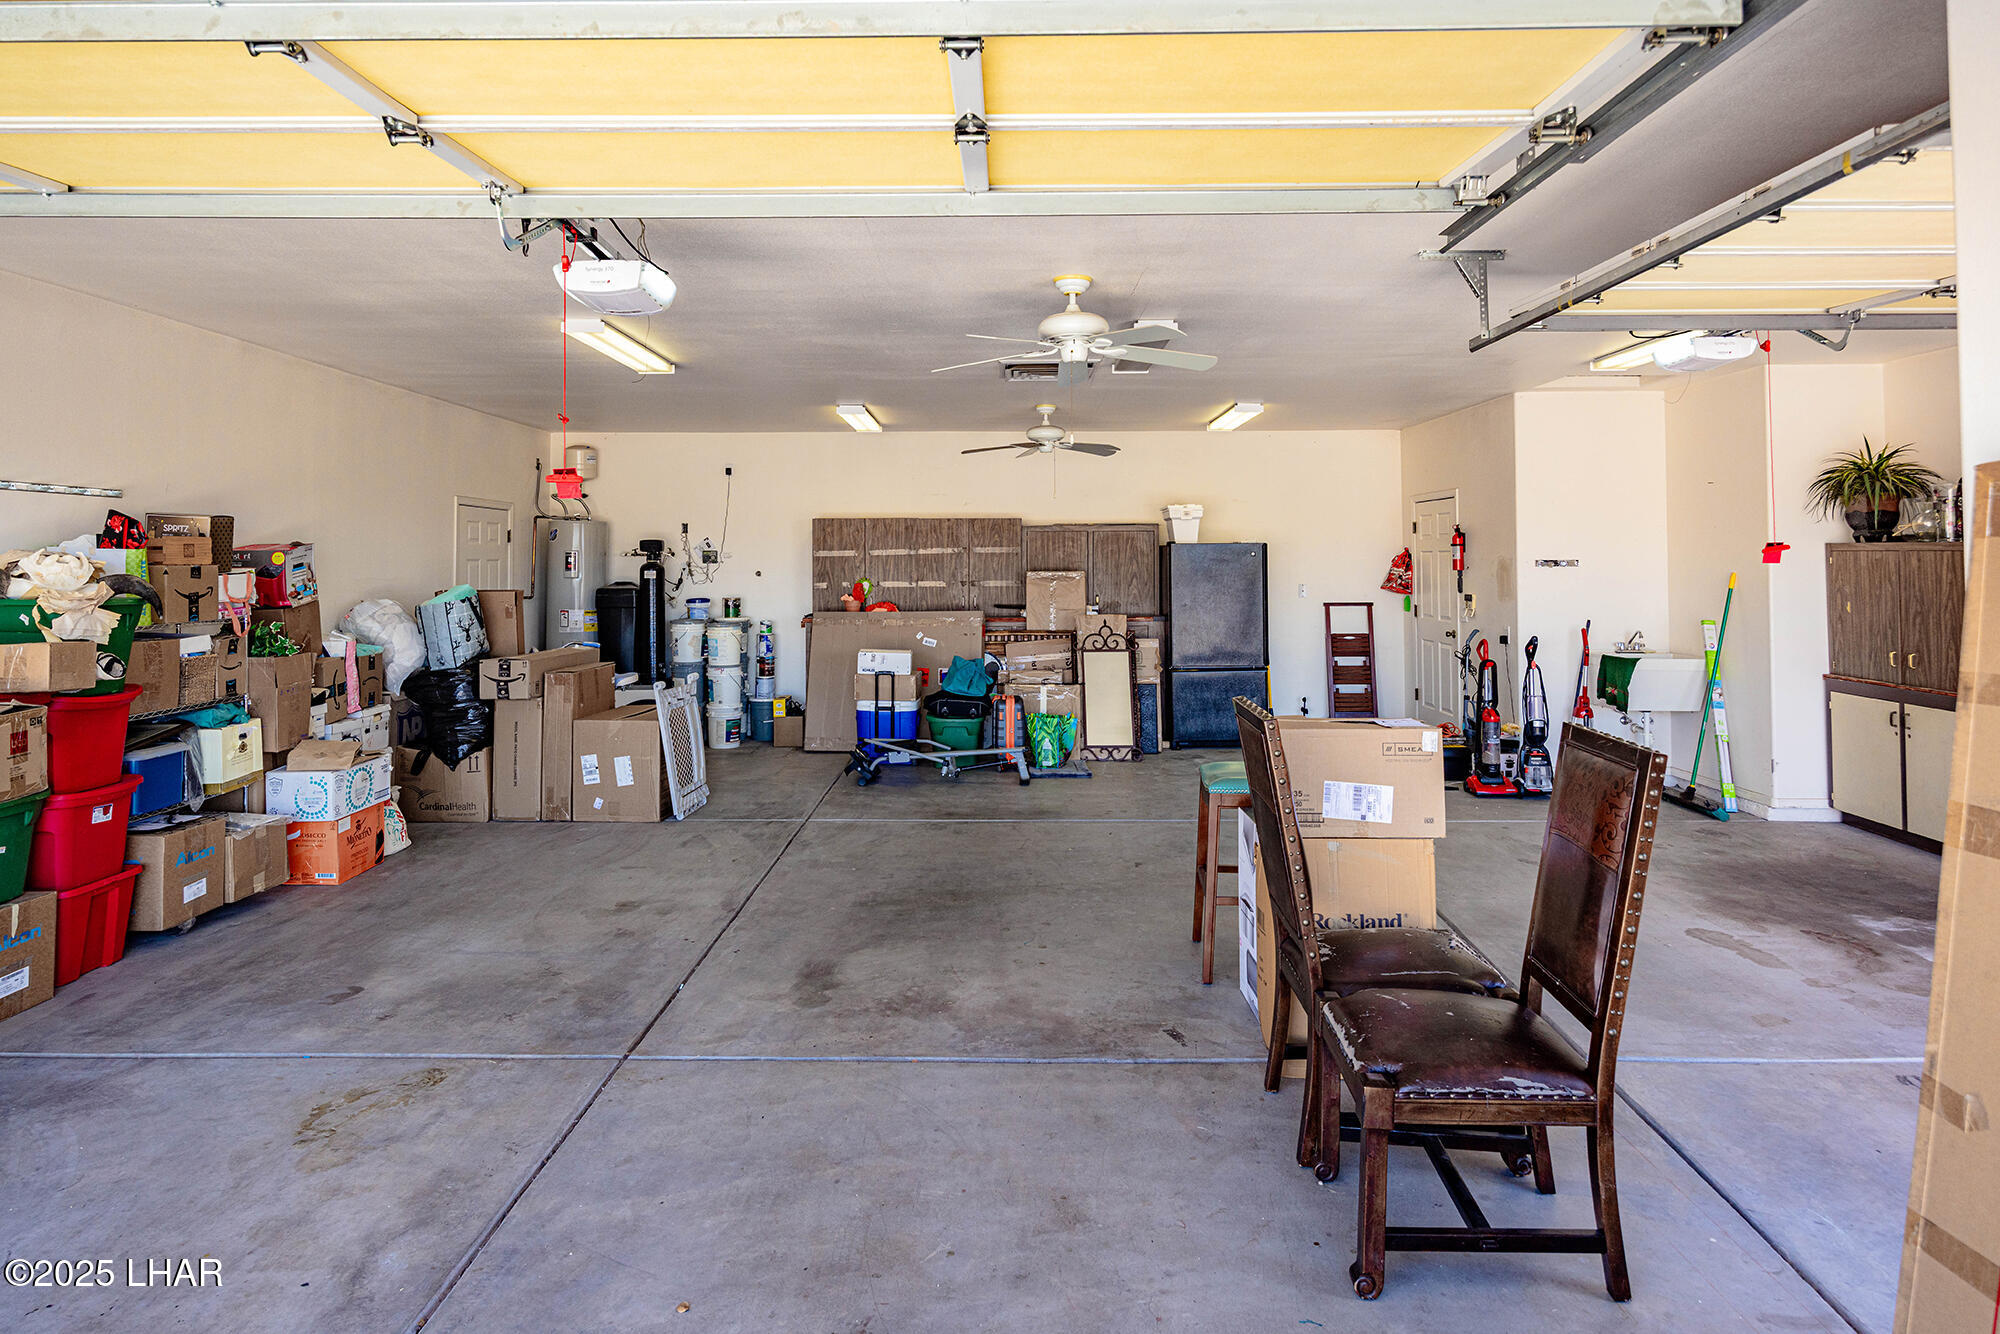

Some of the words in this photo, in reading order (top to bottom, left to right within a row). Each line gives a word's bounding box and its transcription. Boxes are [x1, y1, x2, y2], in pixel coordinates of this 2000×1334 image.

[163, 524, 189, 533] SPRITZ
[175, 846, 216, 868] Alcon
[1312, 912, 1403, 930] Rokland
